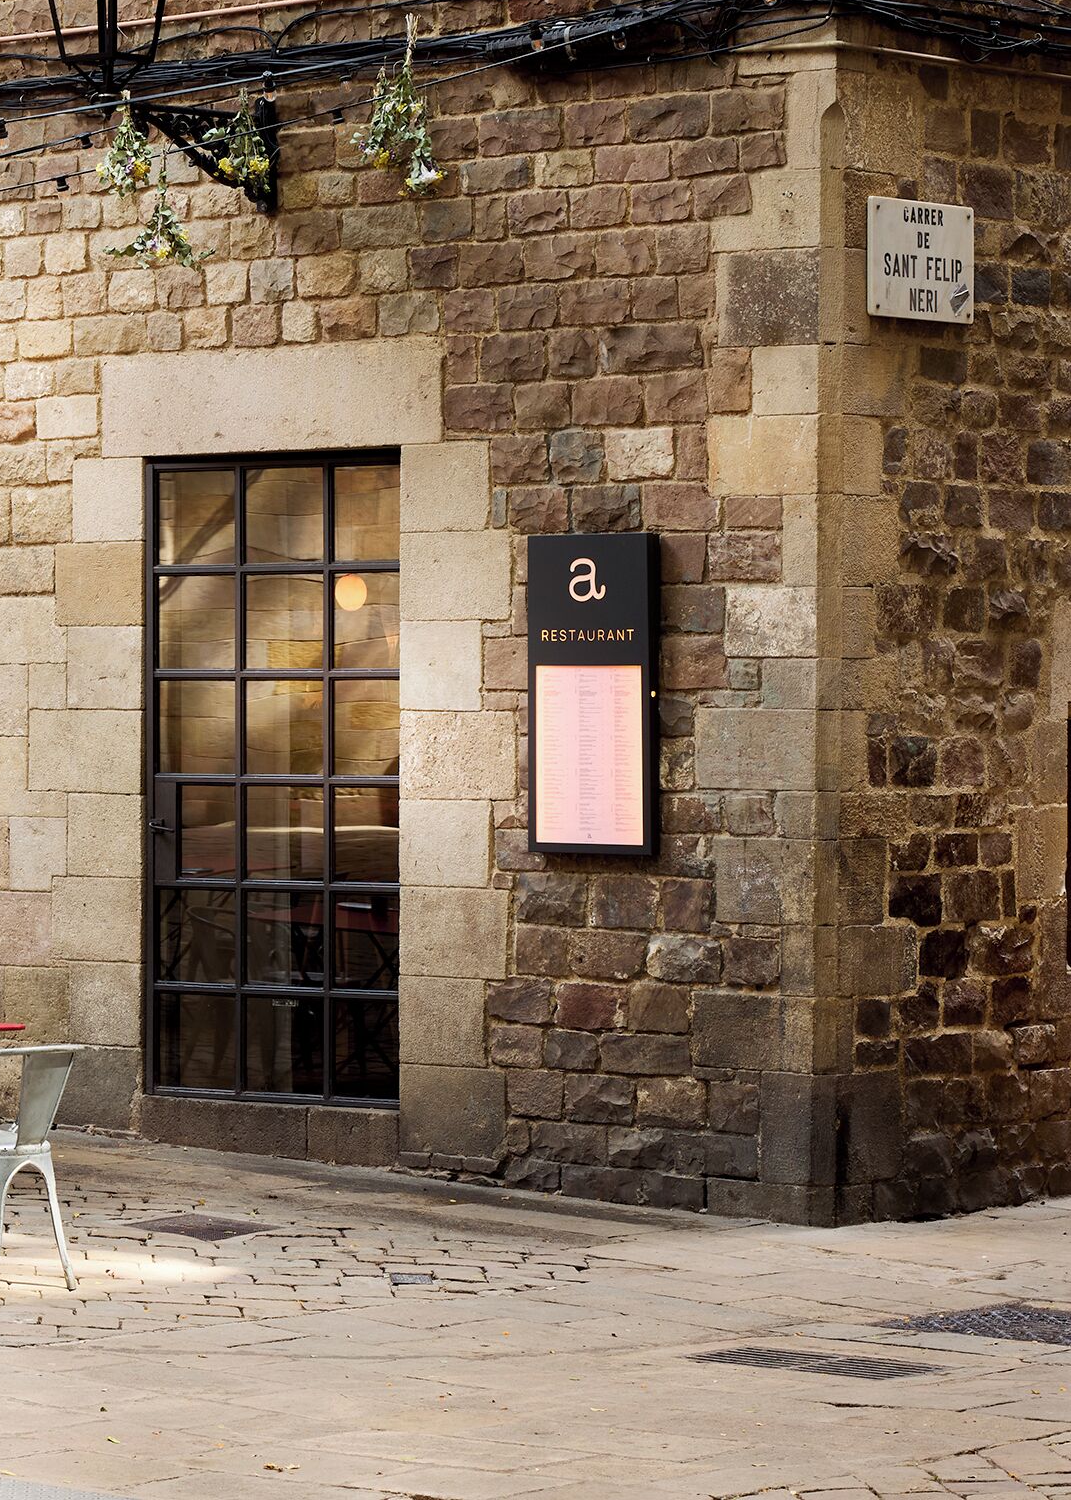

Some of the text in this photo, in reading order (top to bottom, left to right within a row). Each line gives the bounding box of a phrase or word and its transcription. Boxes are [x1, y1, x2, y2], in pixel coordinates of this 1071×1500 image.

[903, 206, 944, 226] CARRER
[917, 231, 930, 249] DE
[884, 252, 963, 283] SANT FELIP
[909, 288, 938, 313] NERI
[568, 557, 606, 602] a
[540, 628, 635, 643] RESTAURANT
